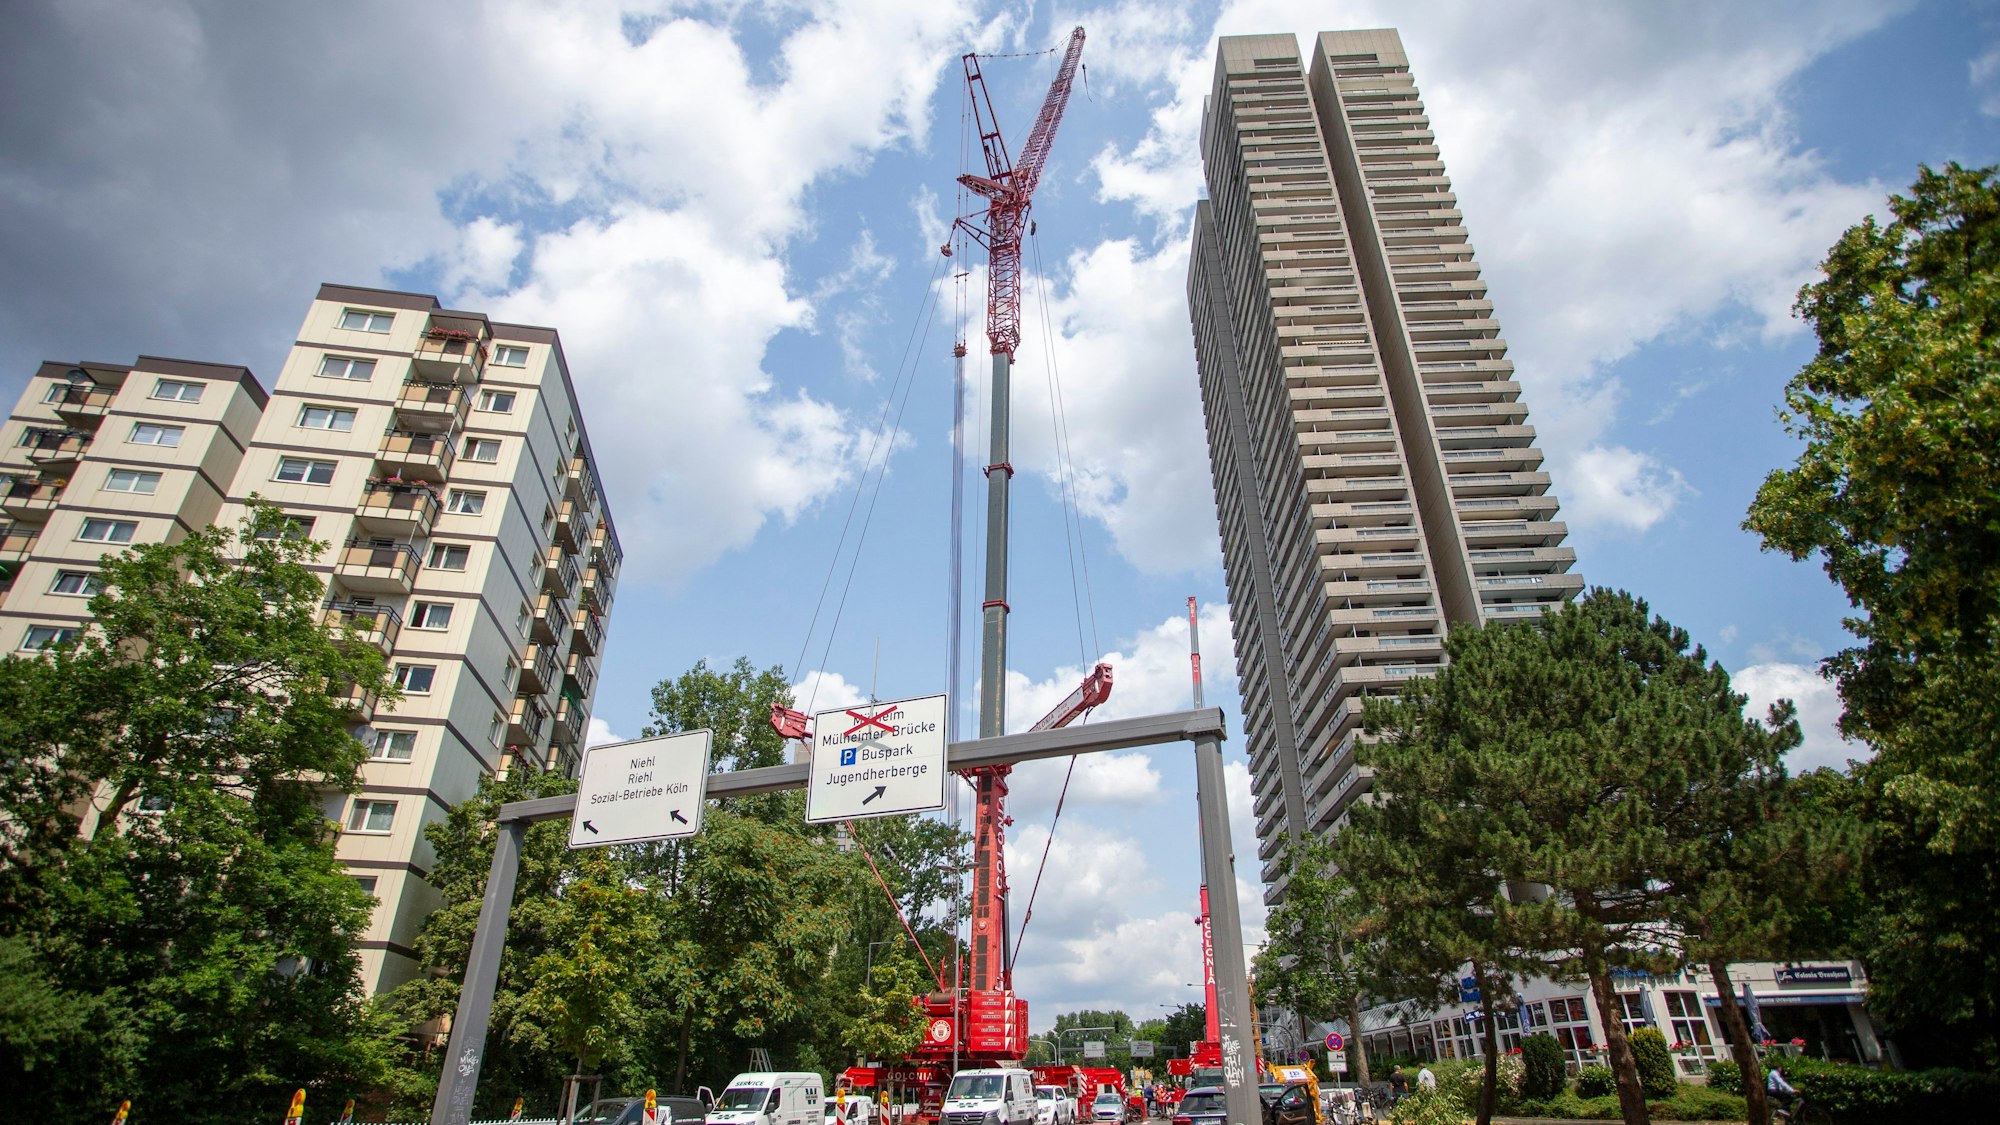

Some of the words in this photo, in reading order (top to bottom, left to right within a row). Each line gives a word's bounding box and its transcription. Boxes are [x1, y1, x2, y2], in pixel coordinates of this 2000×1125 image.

[822, 729, 886, 747] Mülheimer
[892, 721, 936, 738] Brücke
[630, 756, 656, 769] Niehl
[862, 744, 913, 761] Buspark
[627, 771, 653, 784] Riehl
[826, 764, 928, 787] Jugendherberge
[590, 787, 663, 805] Sozial-Betriebe
[666, 782, 688, 794] Köln
